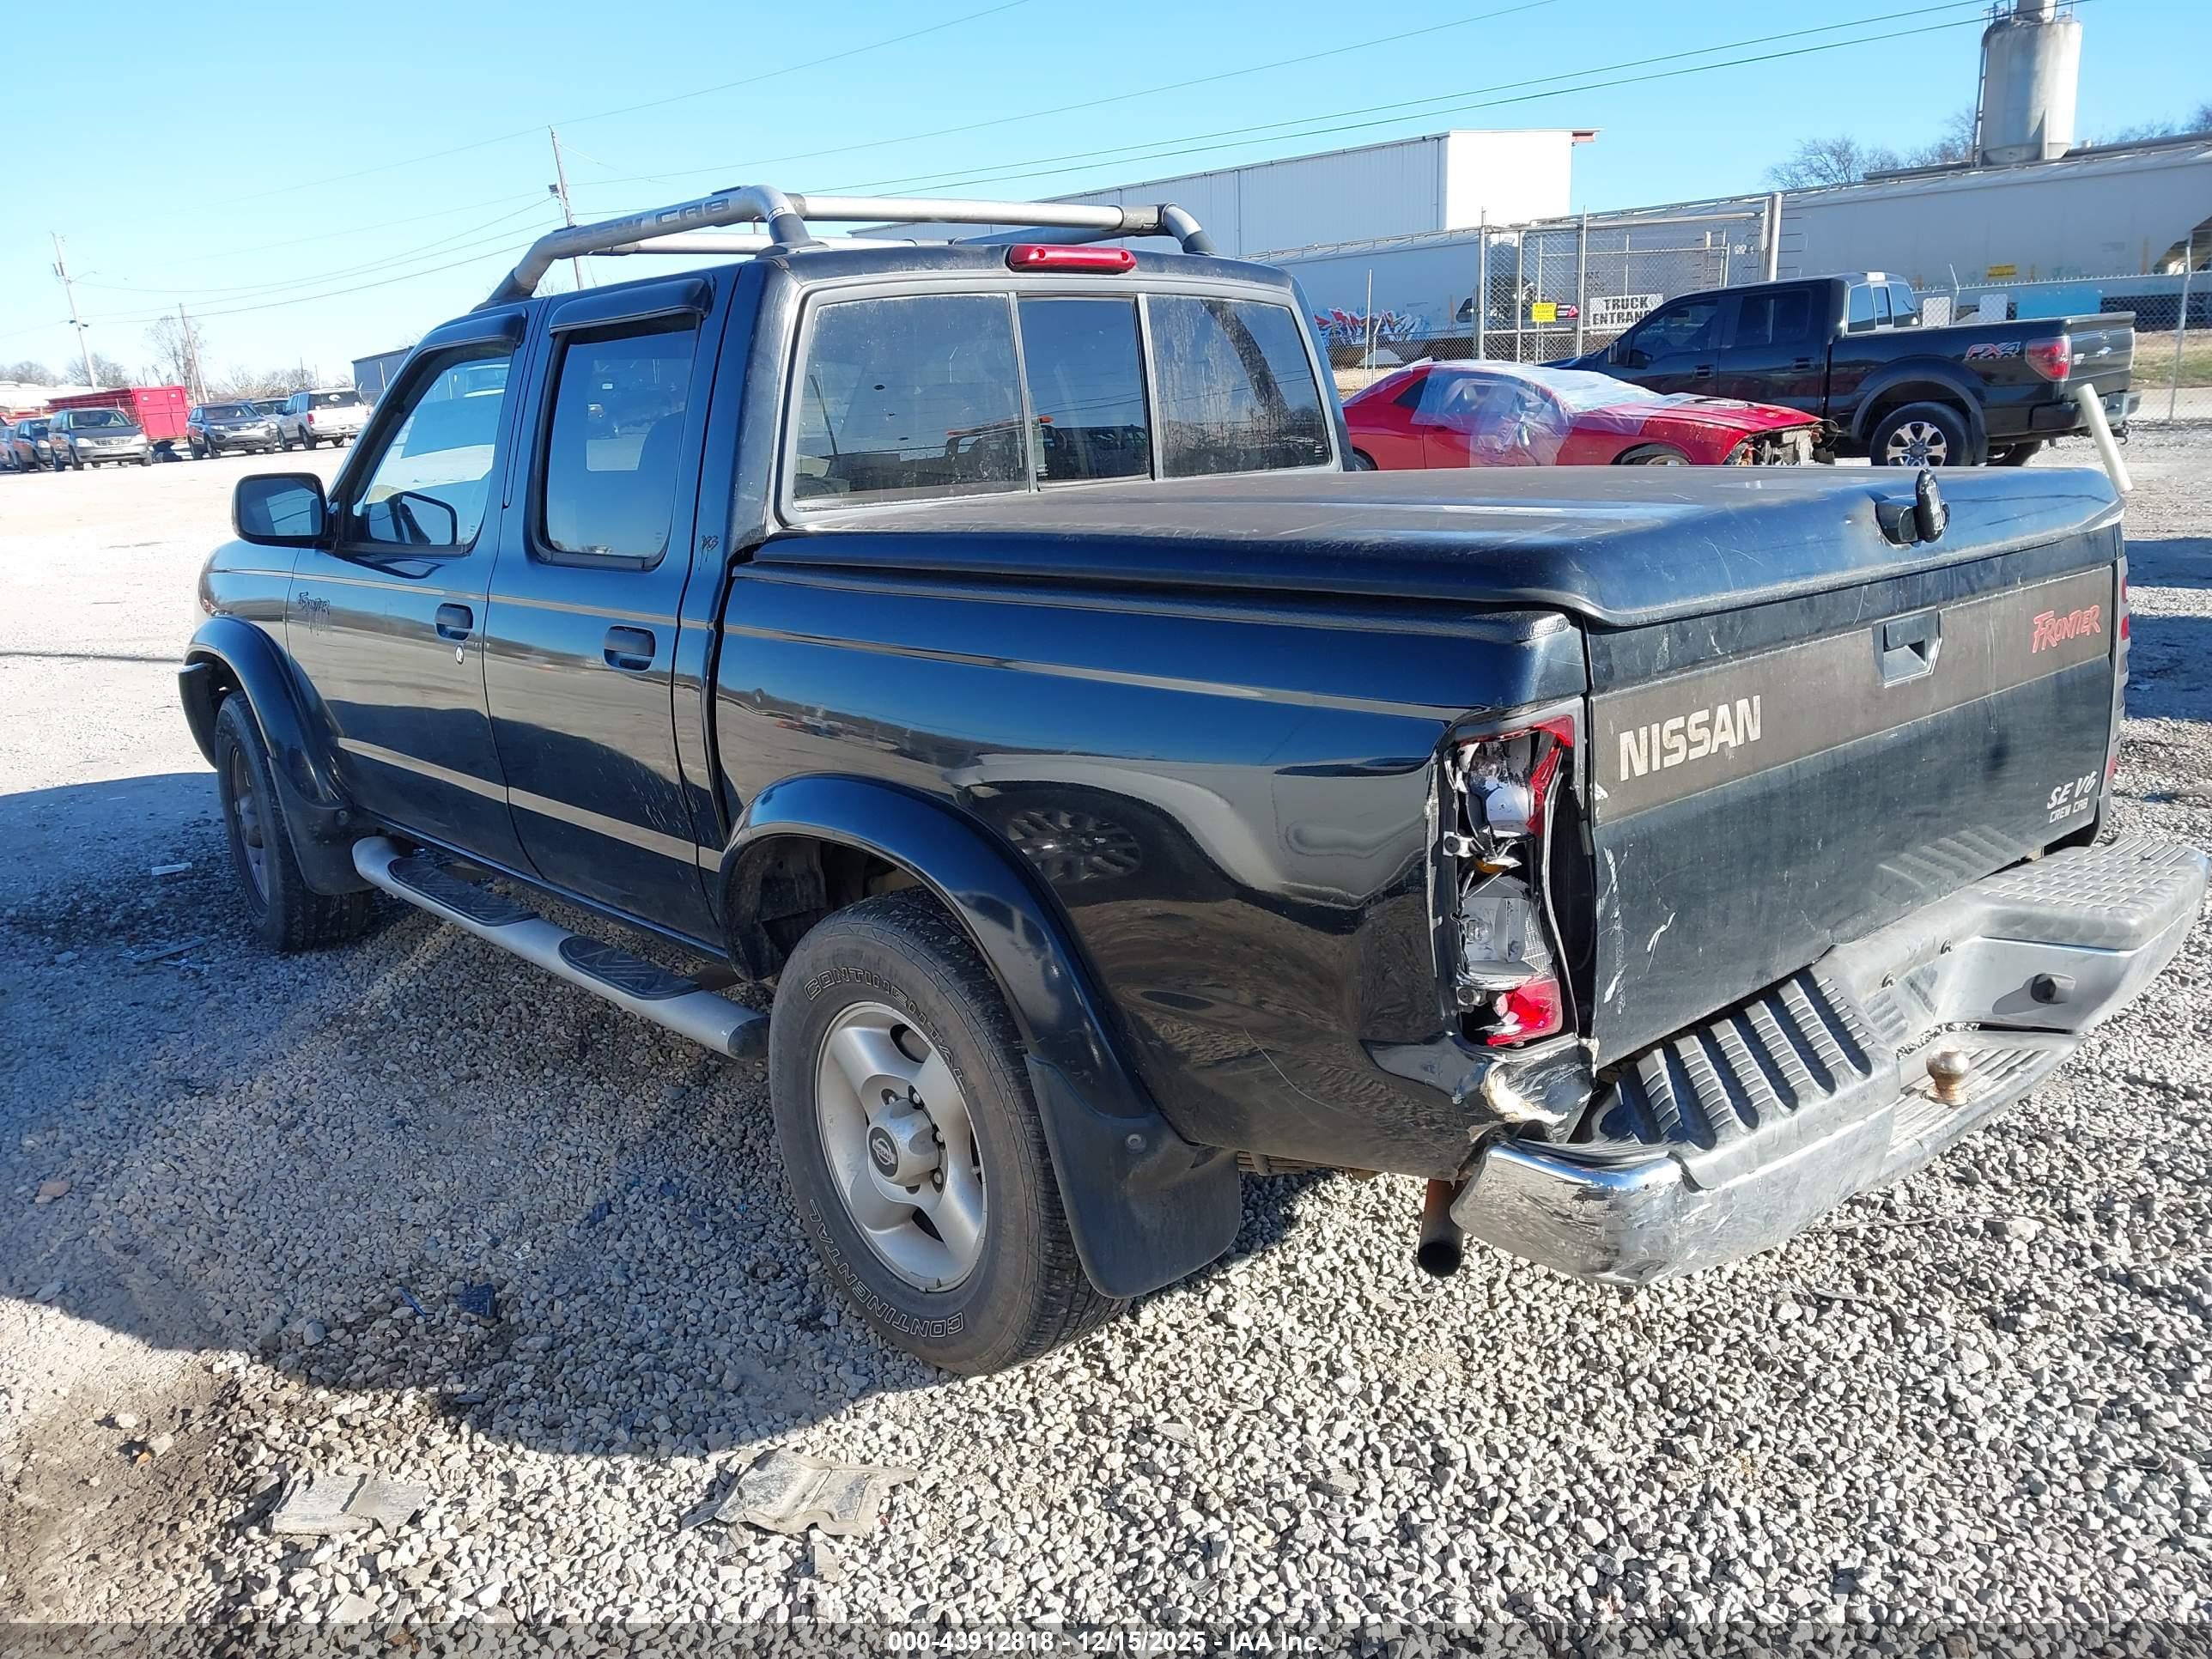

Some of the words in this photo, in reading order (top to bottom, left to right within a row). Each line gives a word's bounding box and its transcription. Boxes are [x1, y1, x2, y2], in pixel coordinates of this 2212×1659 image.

[1604, 296, 1649, 312] TRUCK
[1966, 341, 2021, 358] FX4
[2032, 604, 2101, 653] FRONTIER
[1620, 694, 1761, 782] NISSAN
[2047, 781, 2075, 810] SE
[2074, 770, 2098, 799] V6
[2049, 803, 2072, 823] CREW
[2072, 797, 2089, 814] CAB
[804, 967, 967, 1095] CONTINENTAL
[809, 1199, 963, 1338] CONTINENTAL
